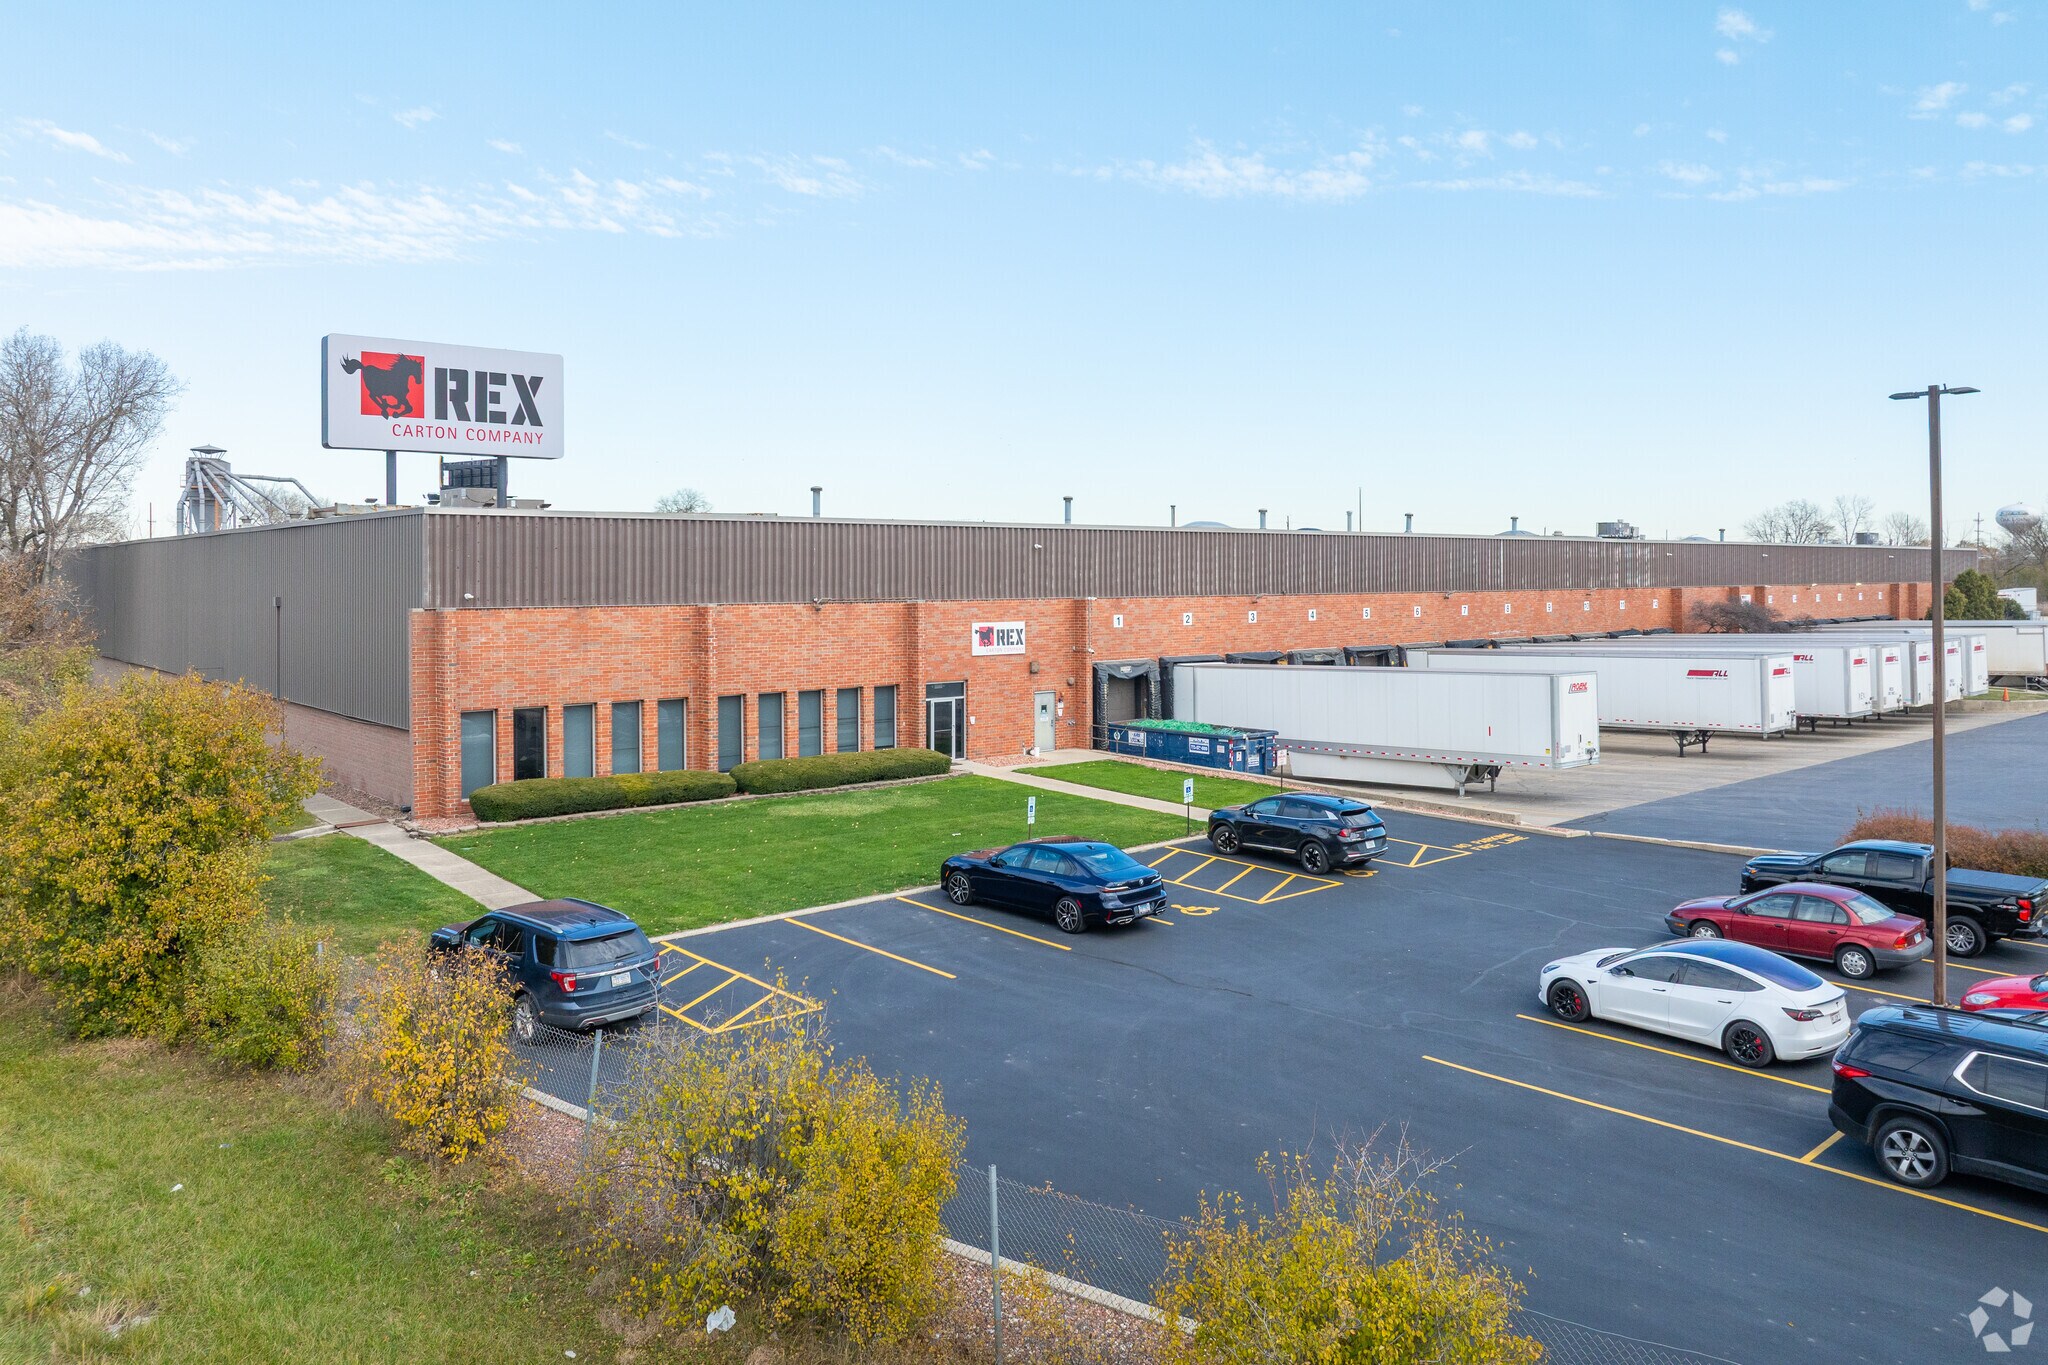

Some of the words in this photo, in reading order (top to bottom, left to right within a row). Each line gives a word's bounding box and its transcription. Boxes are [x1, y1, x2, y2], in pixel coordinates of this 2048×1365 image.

[434, 367, 544, 427] REX
[392, 423, 457, 440] CARTON
[466, 428, 544, 445] COMPANY
[1310, 610, 1315, 619] 4
[1364, 609, 1369, 618] 5
[1415, 607, 1420, 616] 6
[1462, 606, 1468, 614] 7
[1185, 614, 1191, 624] 2
[1250, 612, 1256, 622] 3
[996, 628, 1024, 646] REX
